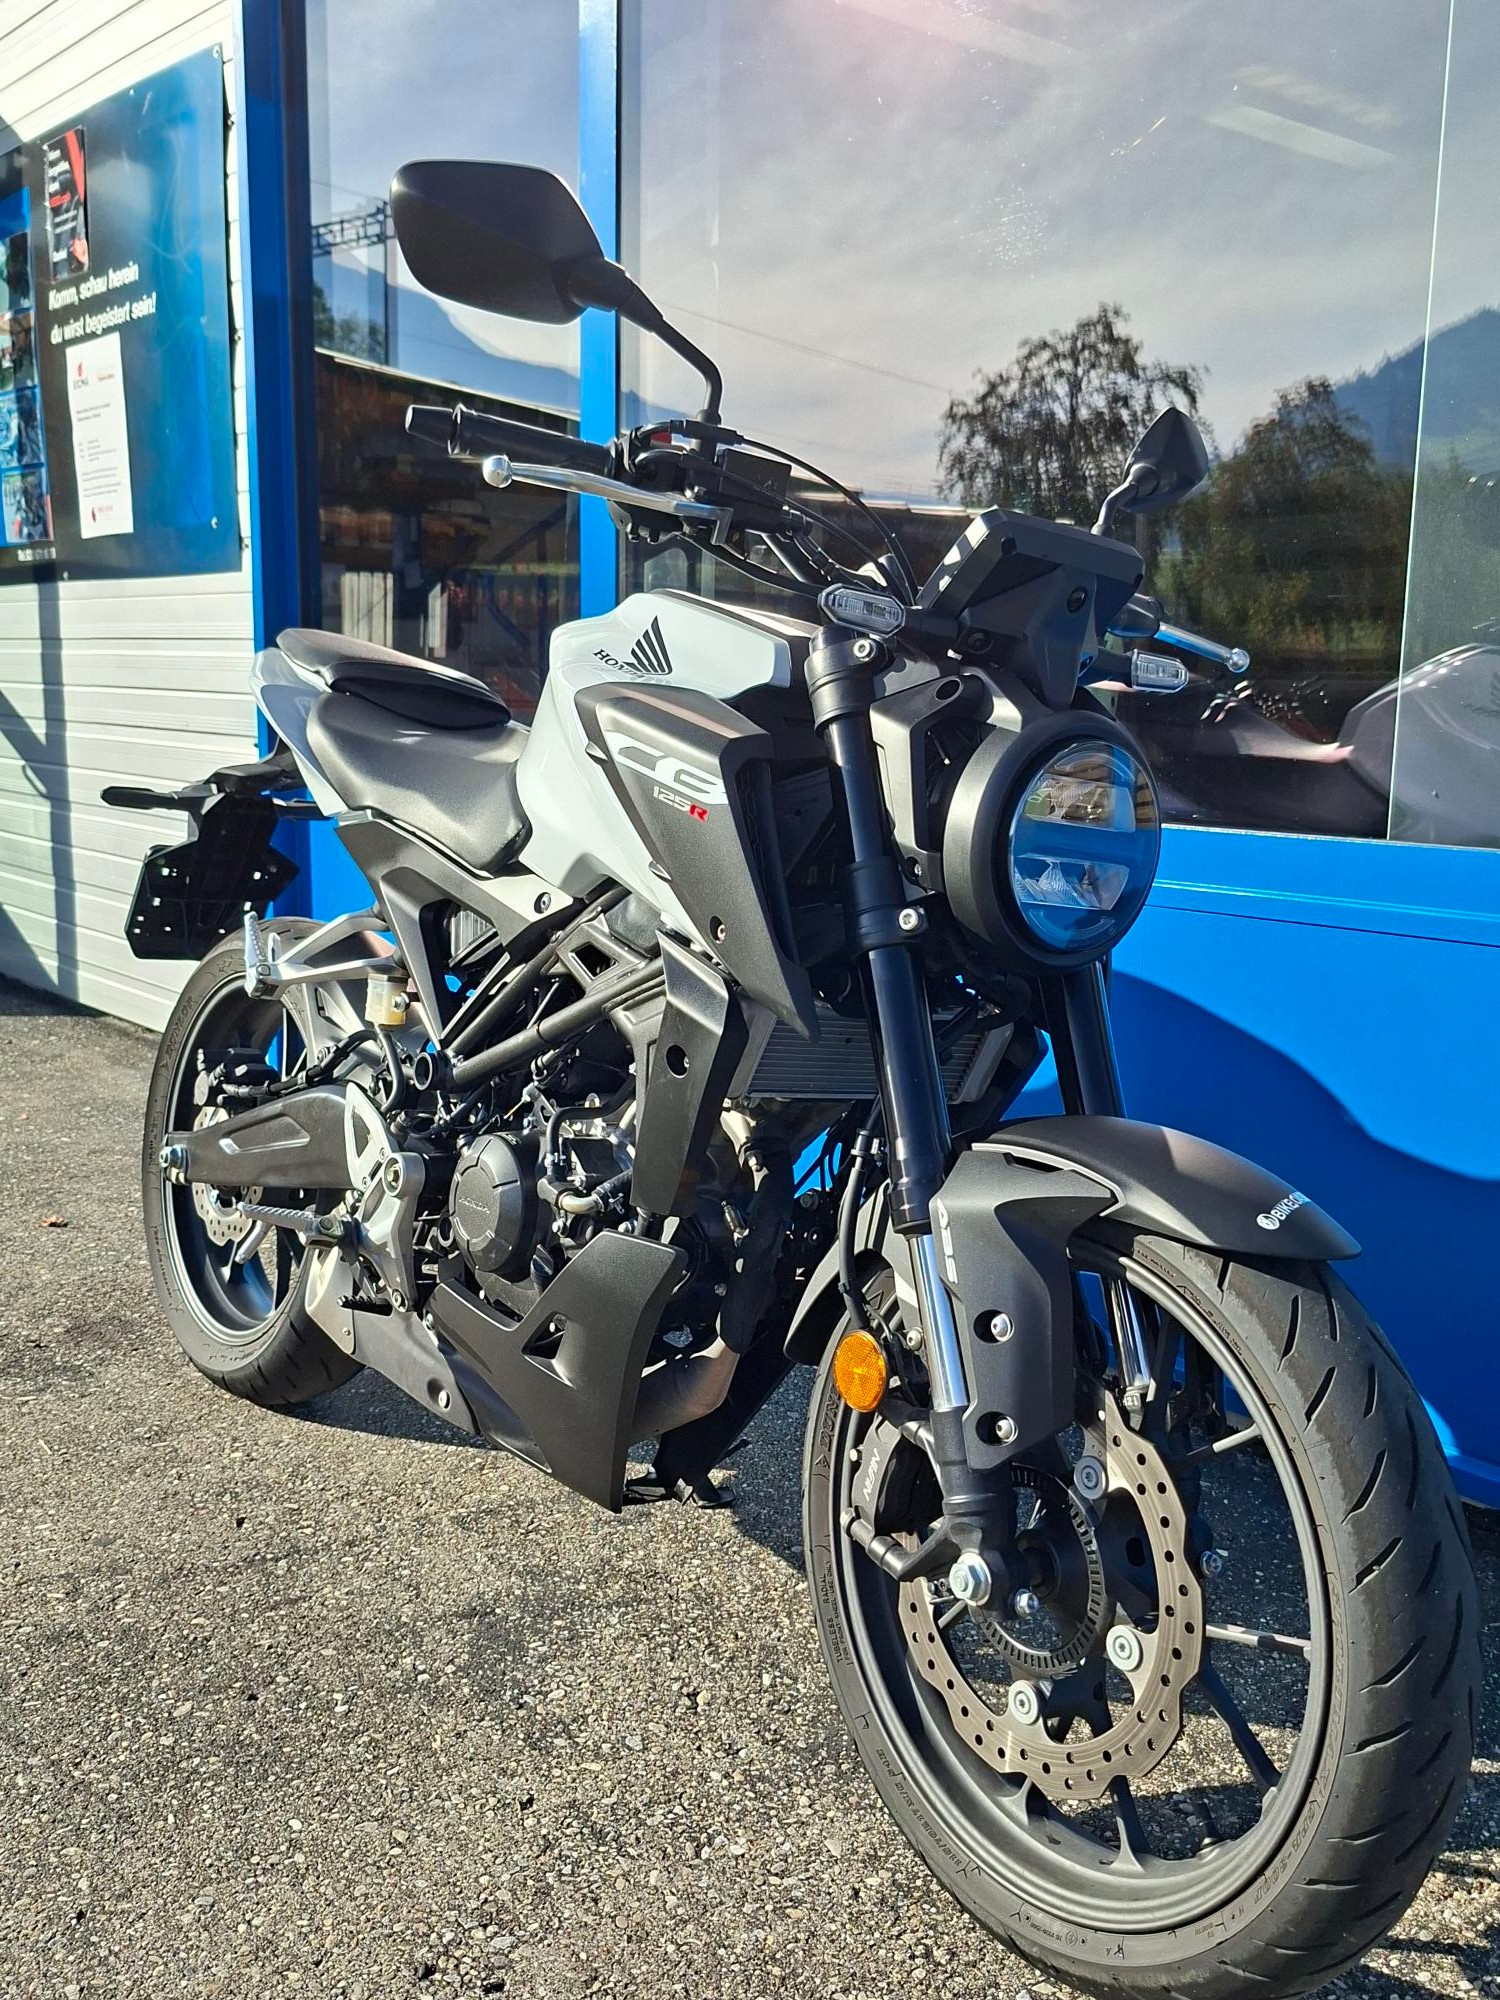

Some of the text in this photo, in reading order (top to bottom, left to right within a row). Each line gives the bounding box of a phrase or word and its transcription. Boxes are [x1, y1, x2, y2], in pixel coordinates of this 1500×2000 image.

[48, 261, 139, 311] Komm, schau herein
[50, 291, 157, 345] du wirst begeistert sein!
[936, 1197, 958, 1285] ABS
[820, 1572, 830, 1604] RADIAL
